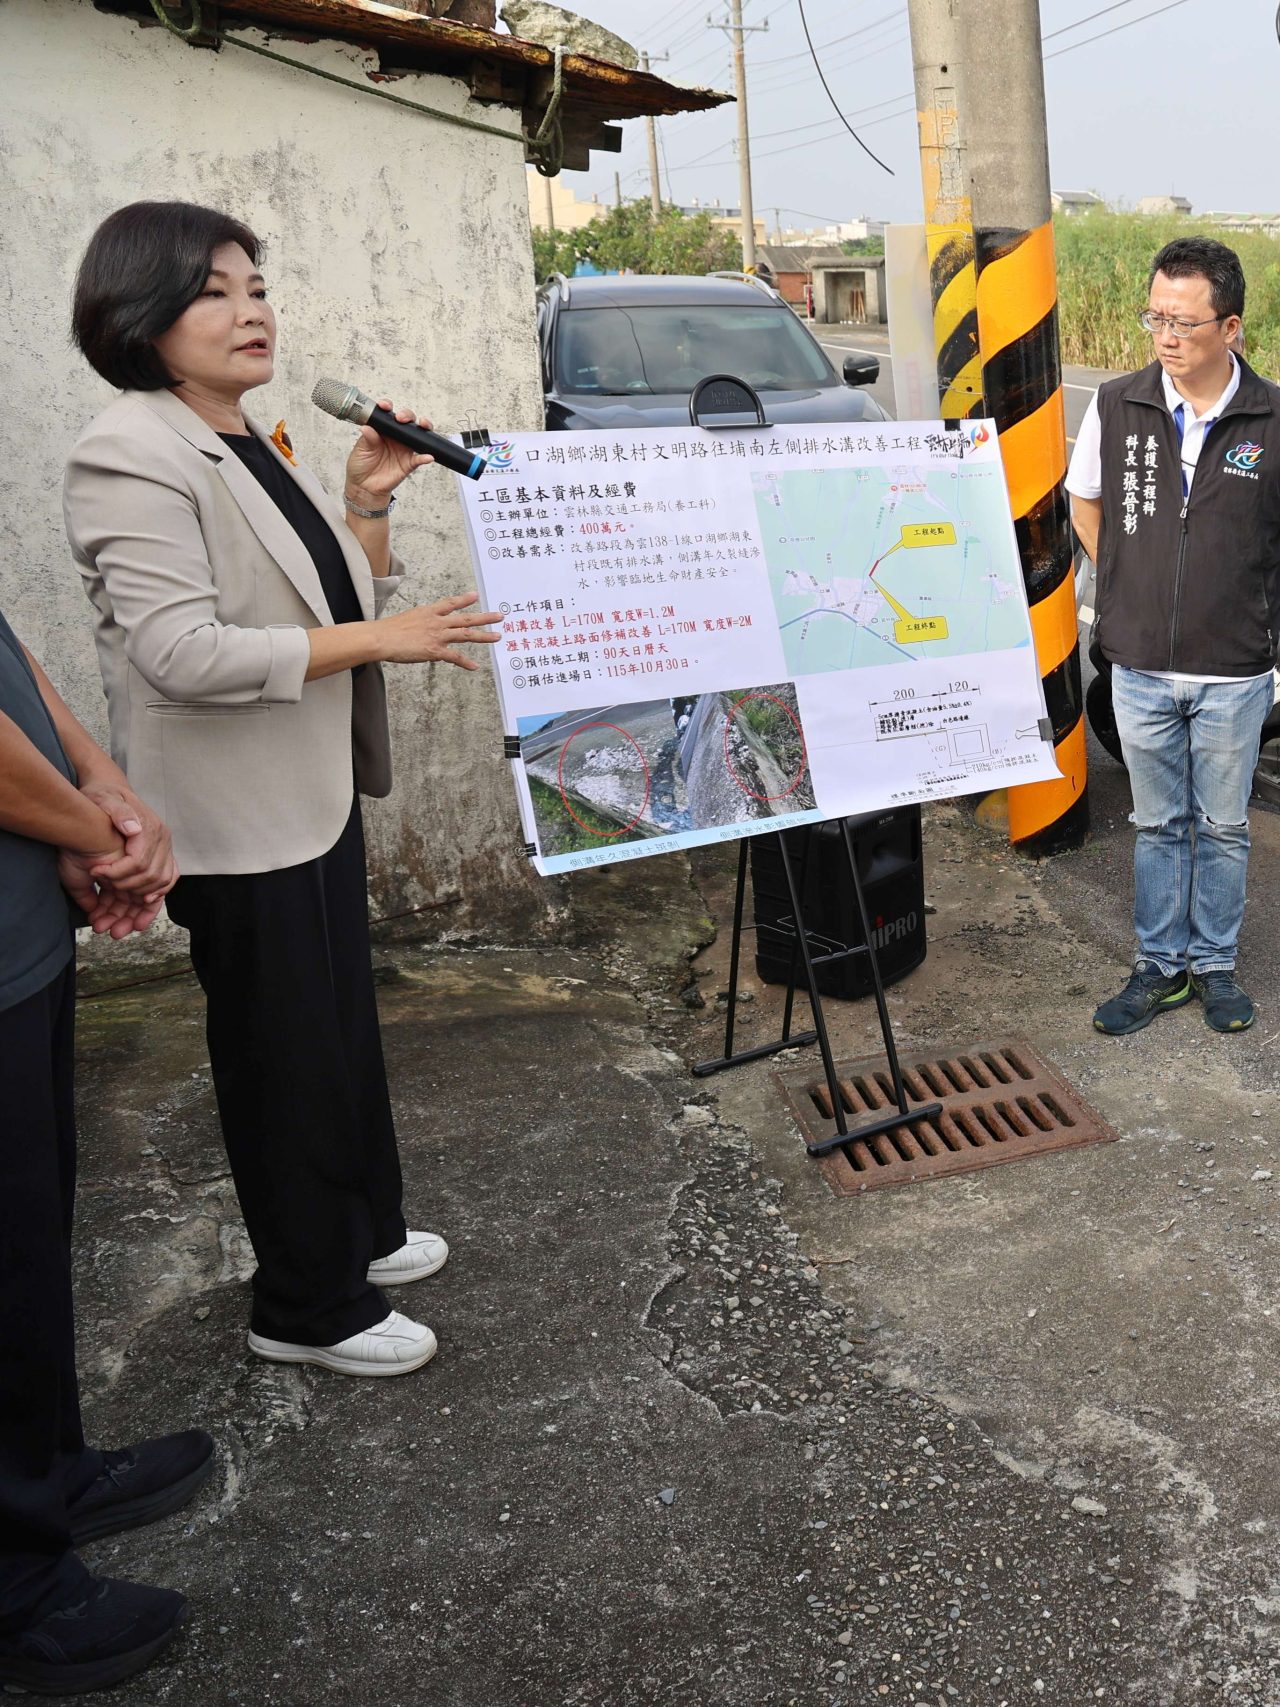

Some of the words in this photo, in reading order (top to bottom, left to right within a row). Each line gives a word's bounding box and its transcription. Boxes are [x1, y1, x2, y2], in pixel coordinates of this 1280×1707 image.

[526, 434, 923, 464] 口湖鄉湖東村文明路往埔南左側排水溝改善工程
[1124, 434, 1139, 466] 科長
[1142, 435, 1159, 517] 養護工程科
[478, 481, 637, 503] 工區基本資料及經費
[502, 617, 556, 633] 側溝改善
[562, 611, 604, 628] L=170M
[611, 605, 675, 623] 寬度W=1.2M
[658, 620, 697, 636] L=170M
[703, 615, 753, 631] 寬度W=2M
[893, 688, 915, 700] 200
[949, 680, 969, 692] 120
